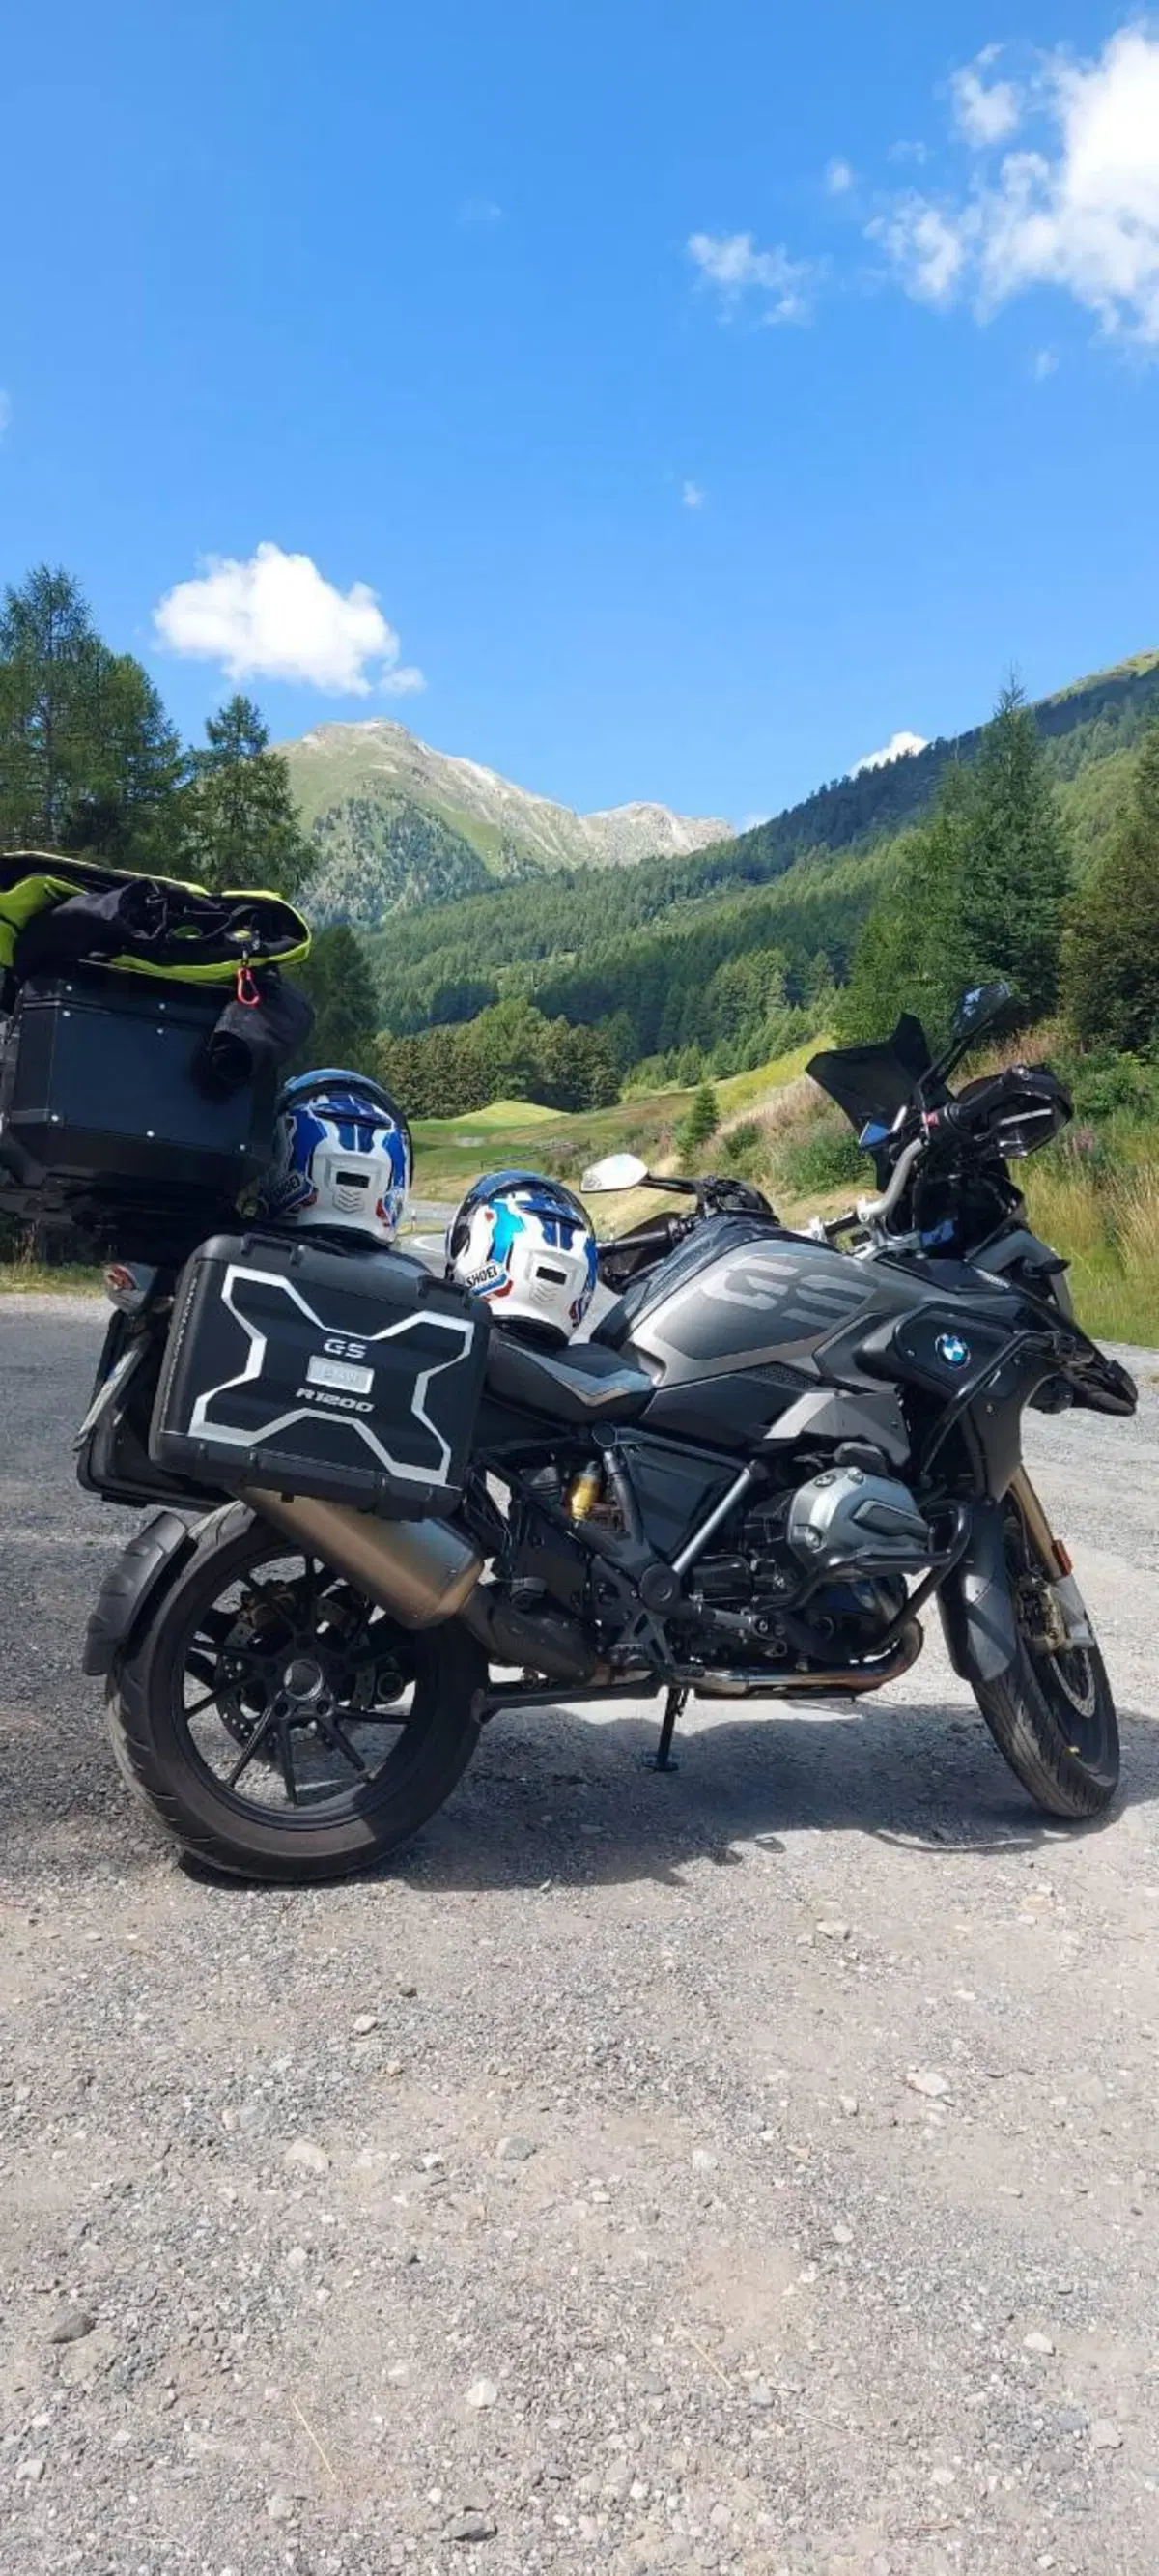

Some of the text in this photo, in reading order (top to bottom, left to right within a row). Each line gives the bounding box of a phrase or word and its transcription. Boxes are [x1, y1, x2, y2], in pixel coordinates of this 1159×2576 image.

[466, 1265, 498, 1288] SHOEI
[700, 1257, 877, 1330] GS
[323, 1338, 367, 1359] GS
[295, 1388, 375, 1413] R1200
